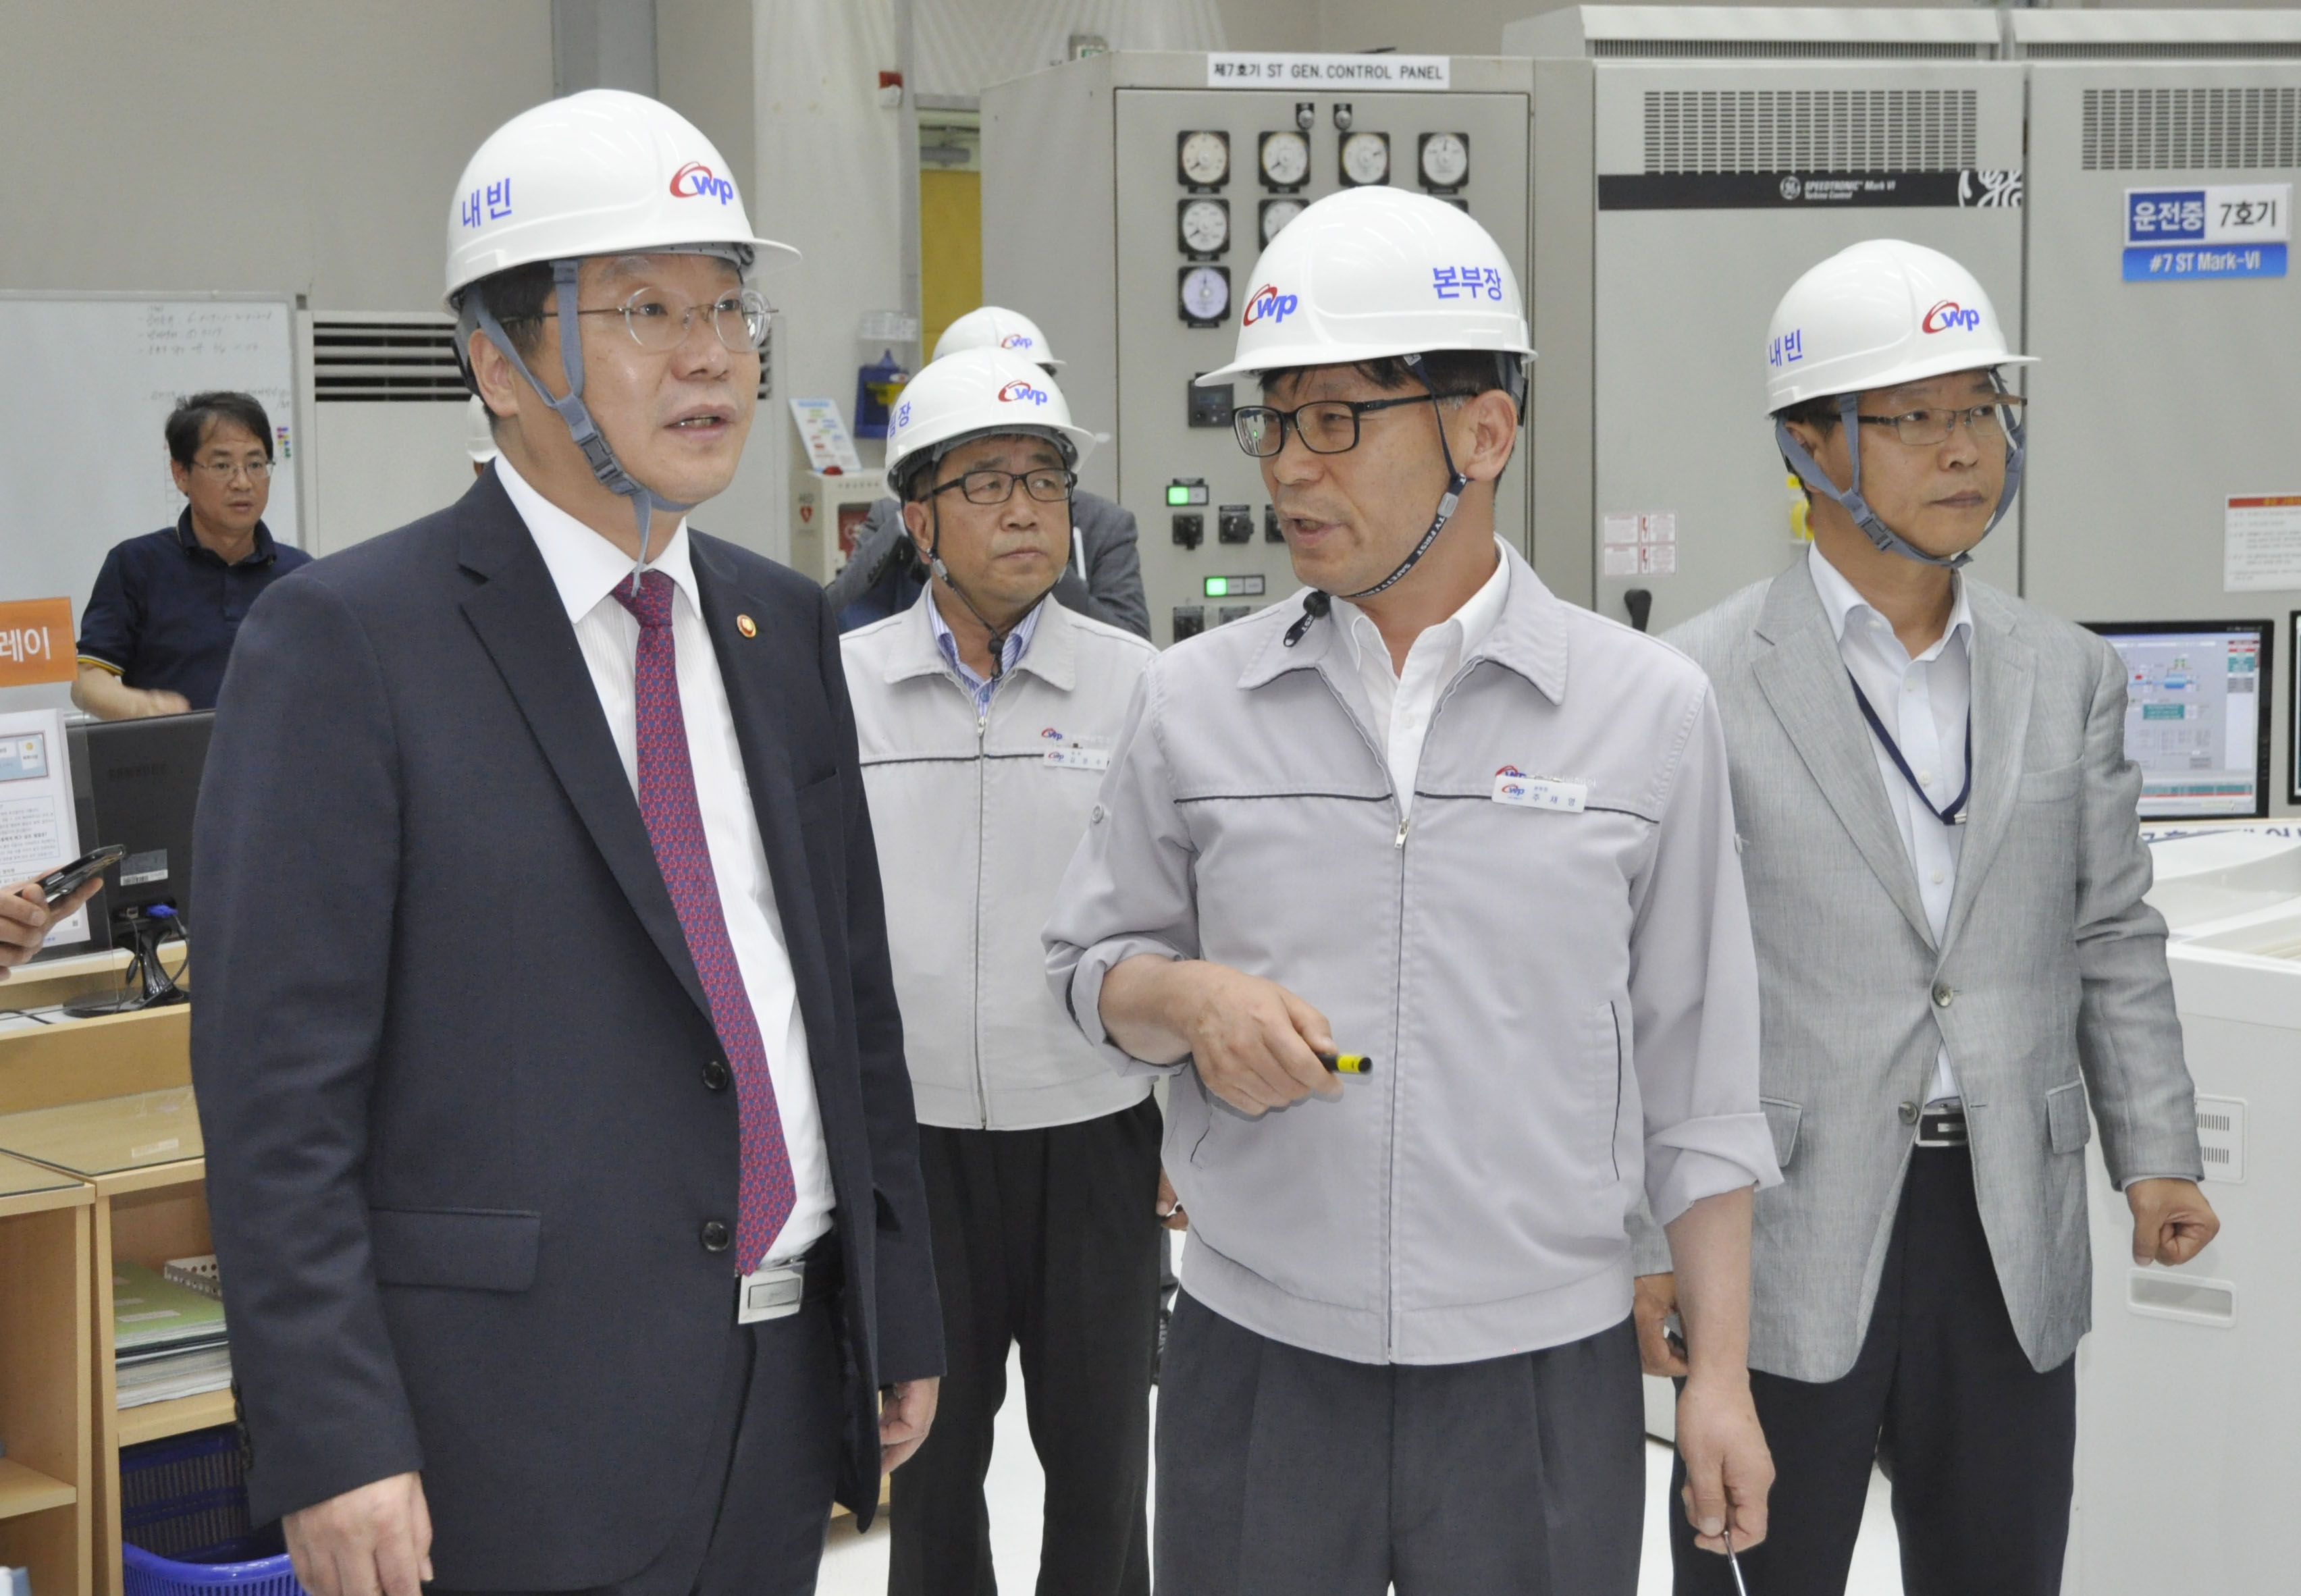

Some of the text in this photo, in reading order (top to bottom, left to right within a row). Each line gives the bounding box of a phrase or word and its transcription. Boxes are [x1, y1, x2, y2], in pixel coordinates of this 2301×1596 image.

[1215, 62, 1443, 80] 제7호기 ST GEN. CONTROL PANEL
[462, 178, 512, 228] 내빈
[2132, 199, 2276, 232] 운전중 7호기
[2149, 250, 2261, 273] #7 ST Mark-VI
[1432, 265, 1502, 301] 본부장
[1769, 329, 1803, 367] 내빈
